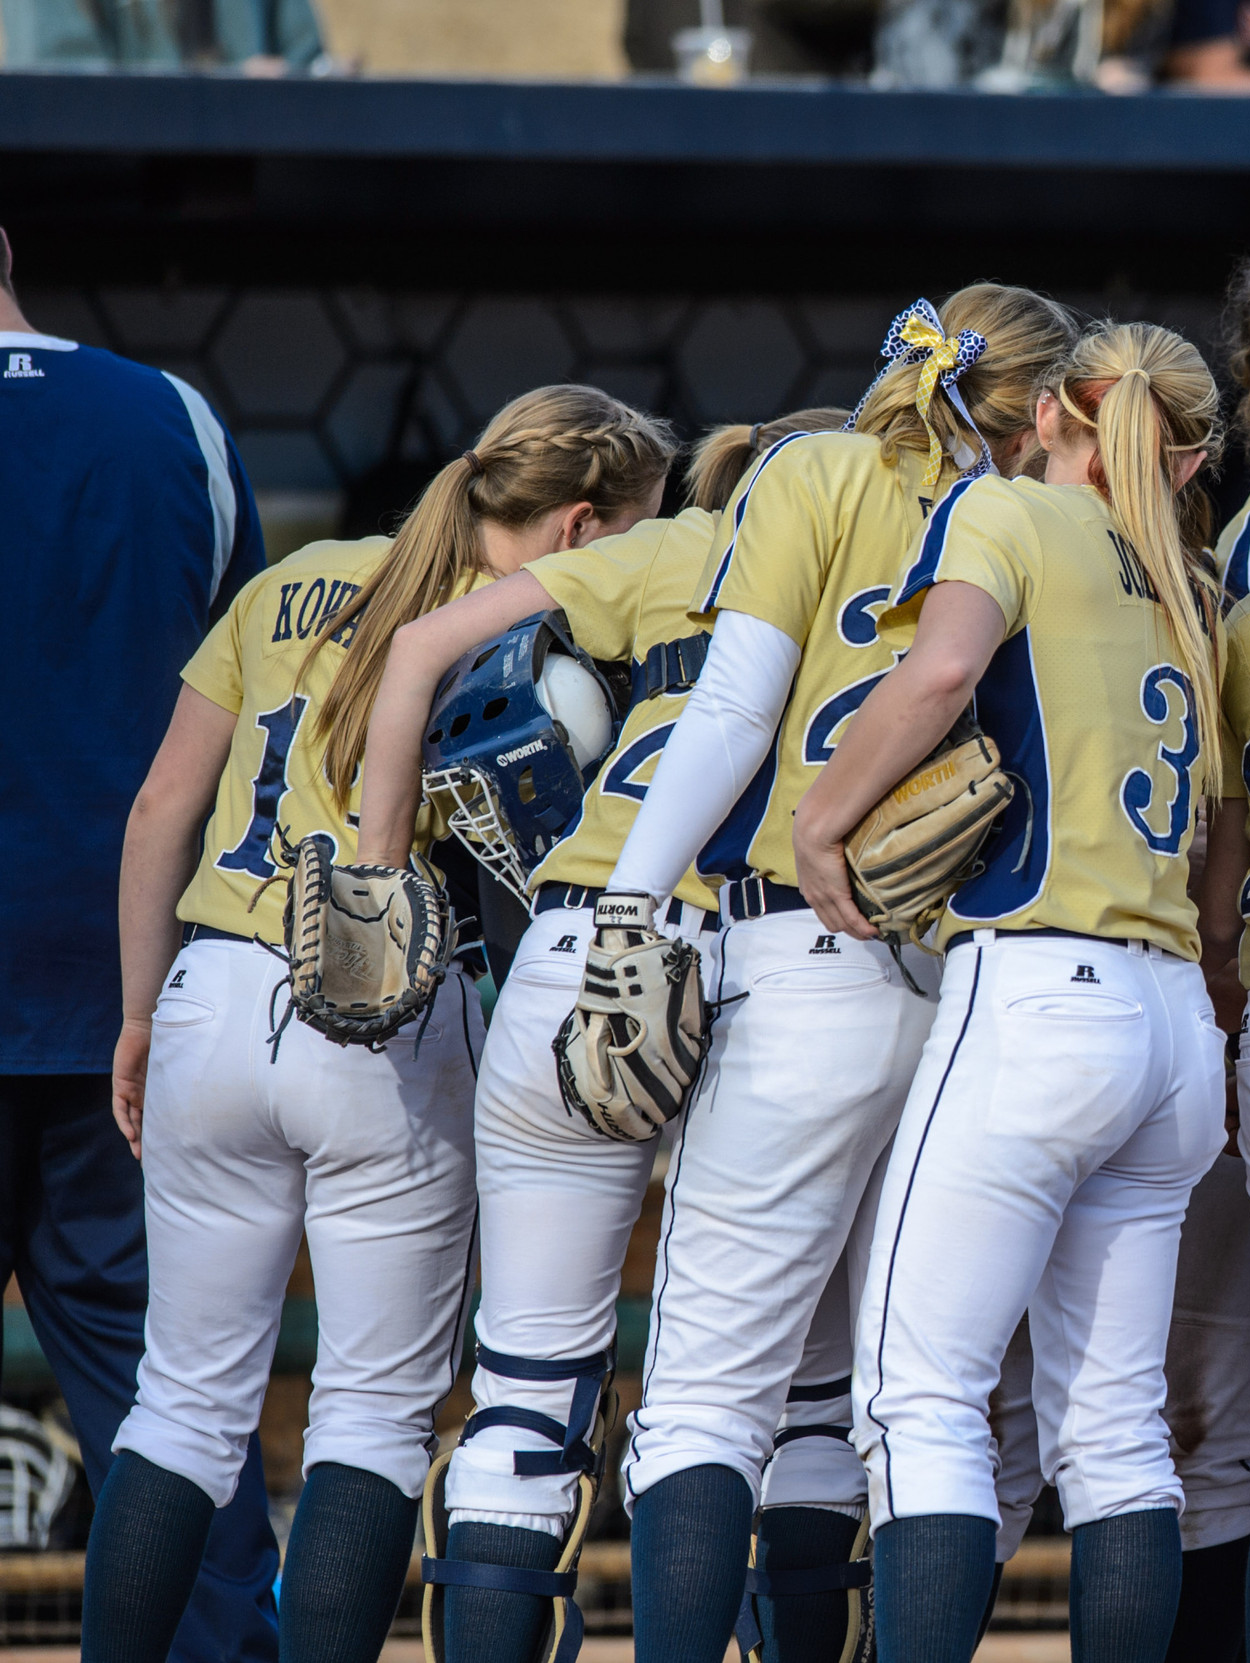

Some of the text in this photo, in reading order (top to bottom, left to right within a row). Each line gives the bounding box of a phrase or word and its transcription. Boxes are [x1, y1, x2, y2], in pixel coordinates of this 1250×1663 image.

[3, 369, 46, 379] RUSSELL
[506, 739, 544, 763] WORTH
[1119, 662, 1203, 858] 3
[893, 761, 956, 805] WORTH
[597, 1103, 637, 1140] WORTH
